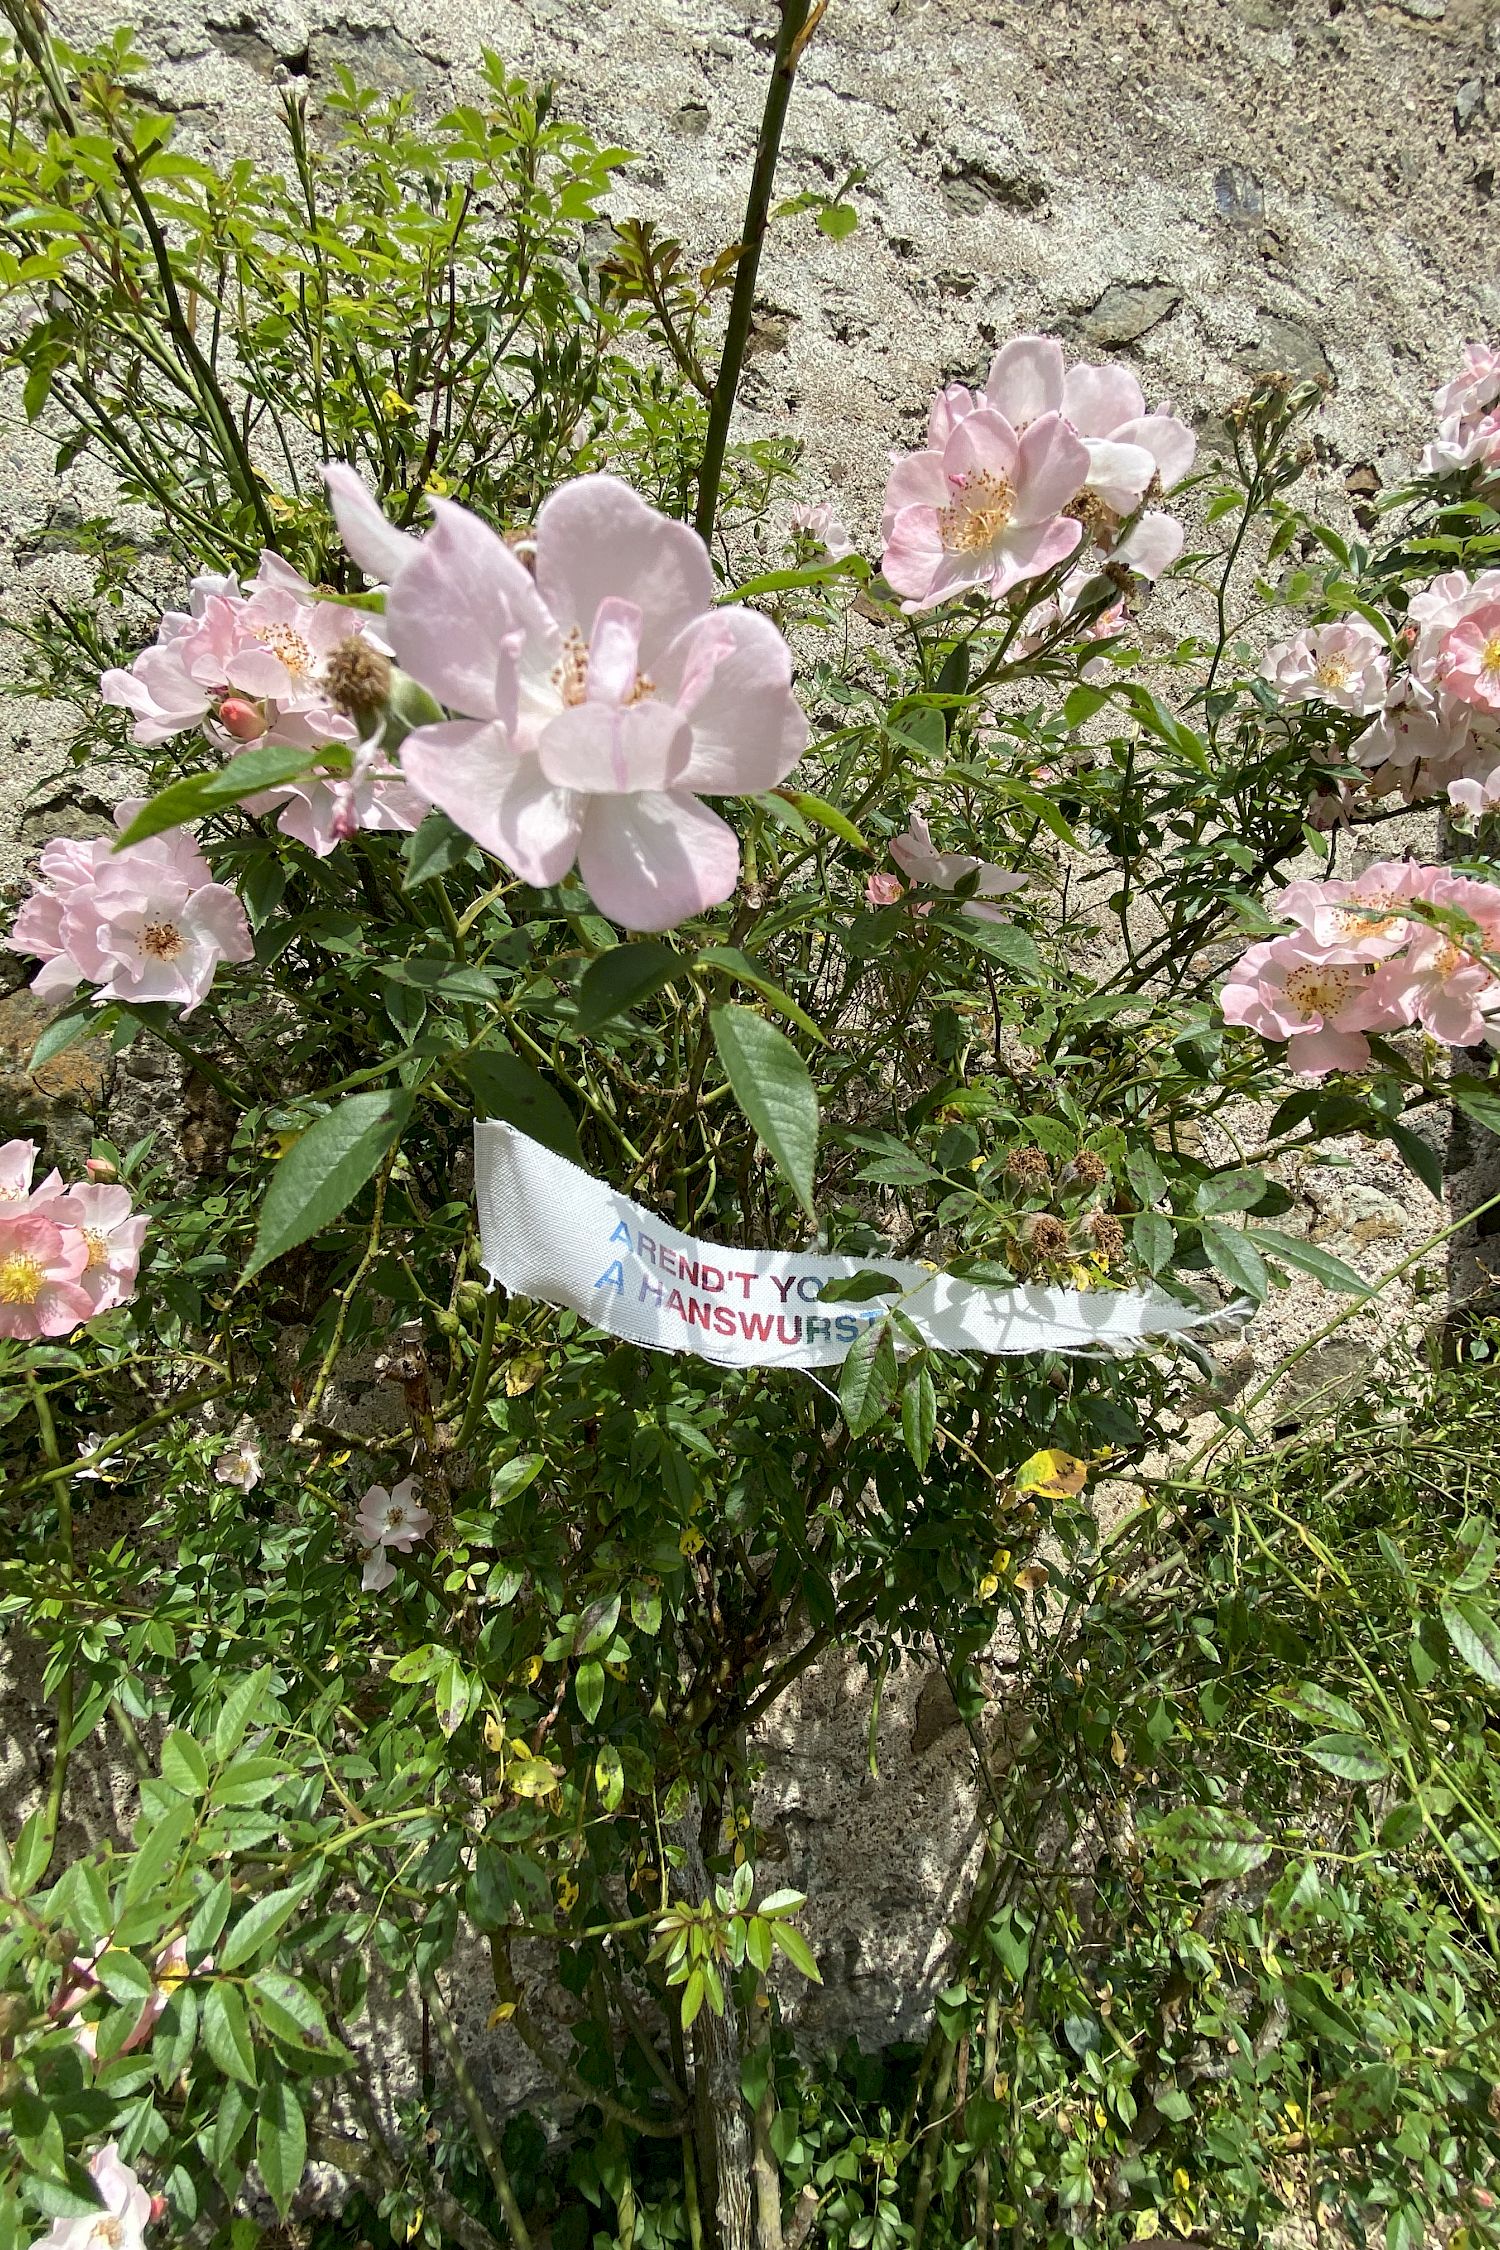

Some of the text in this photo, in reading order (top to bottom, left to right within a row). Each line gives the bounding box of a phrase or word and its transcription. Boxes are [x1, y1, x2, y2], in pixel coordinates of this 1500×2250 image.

[593, 1259, 625, 1296] A
[608, 1220, 852, 1303] AREND'T YO
